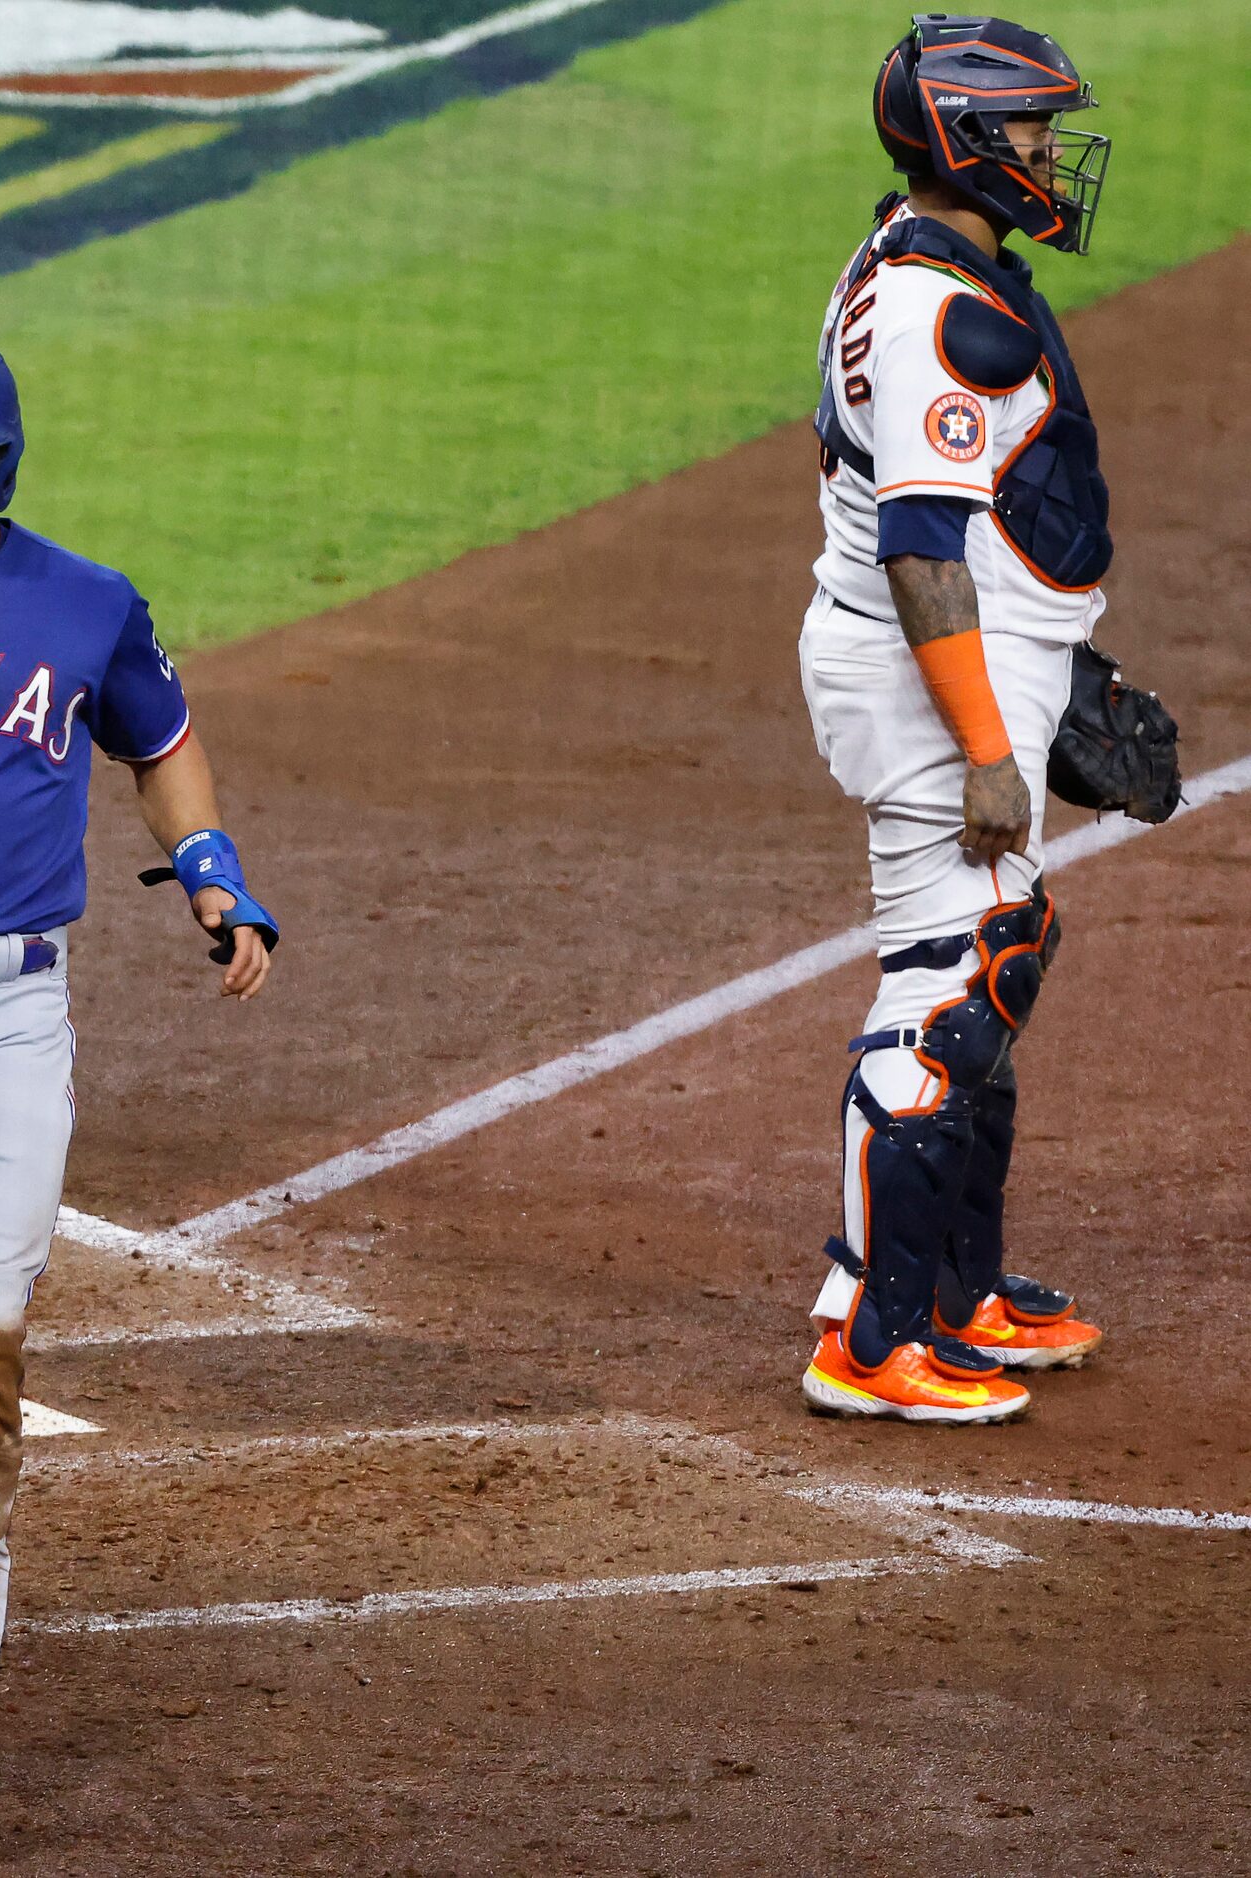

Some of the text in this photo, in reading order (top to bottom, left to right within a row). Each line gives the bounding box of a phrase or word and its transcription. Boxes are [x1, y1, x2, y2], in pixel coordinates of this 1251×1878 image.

[933, 395, 982, 418] HOUSTON
[946, 413, 971, 441] H
[934, 439, 979, 459] ASTROS
[198, 856, 212, 873] 2
